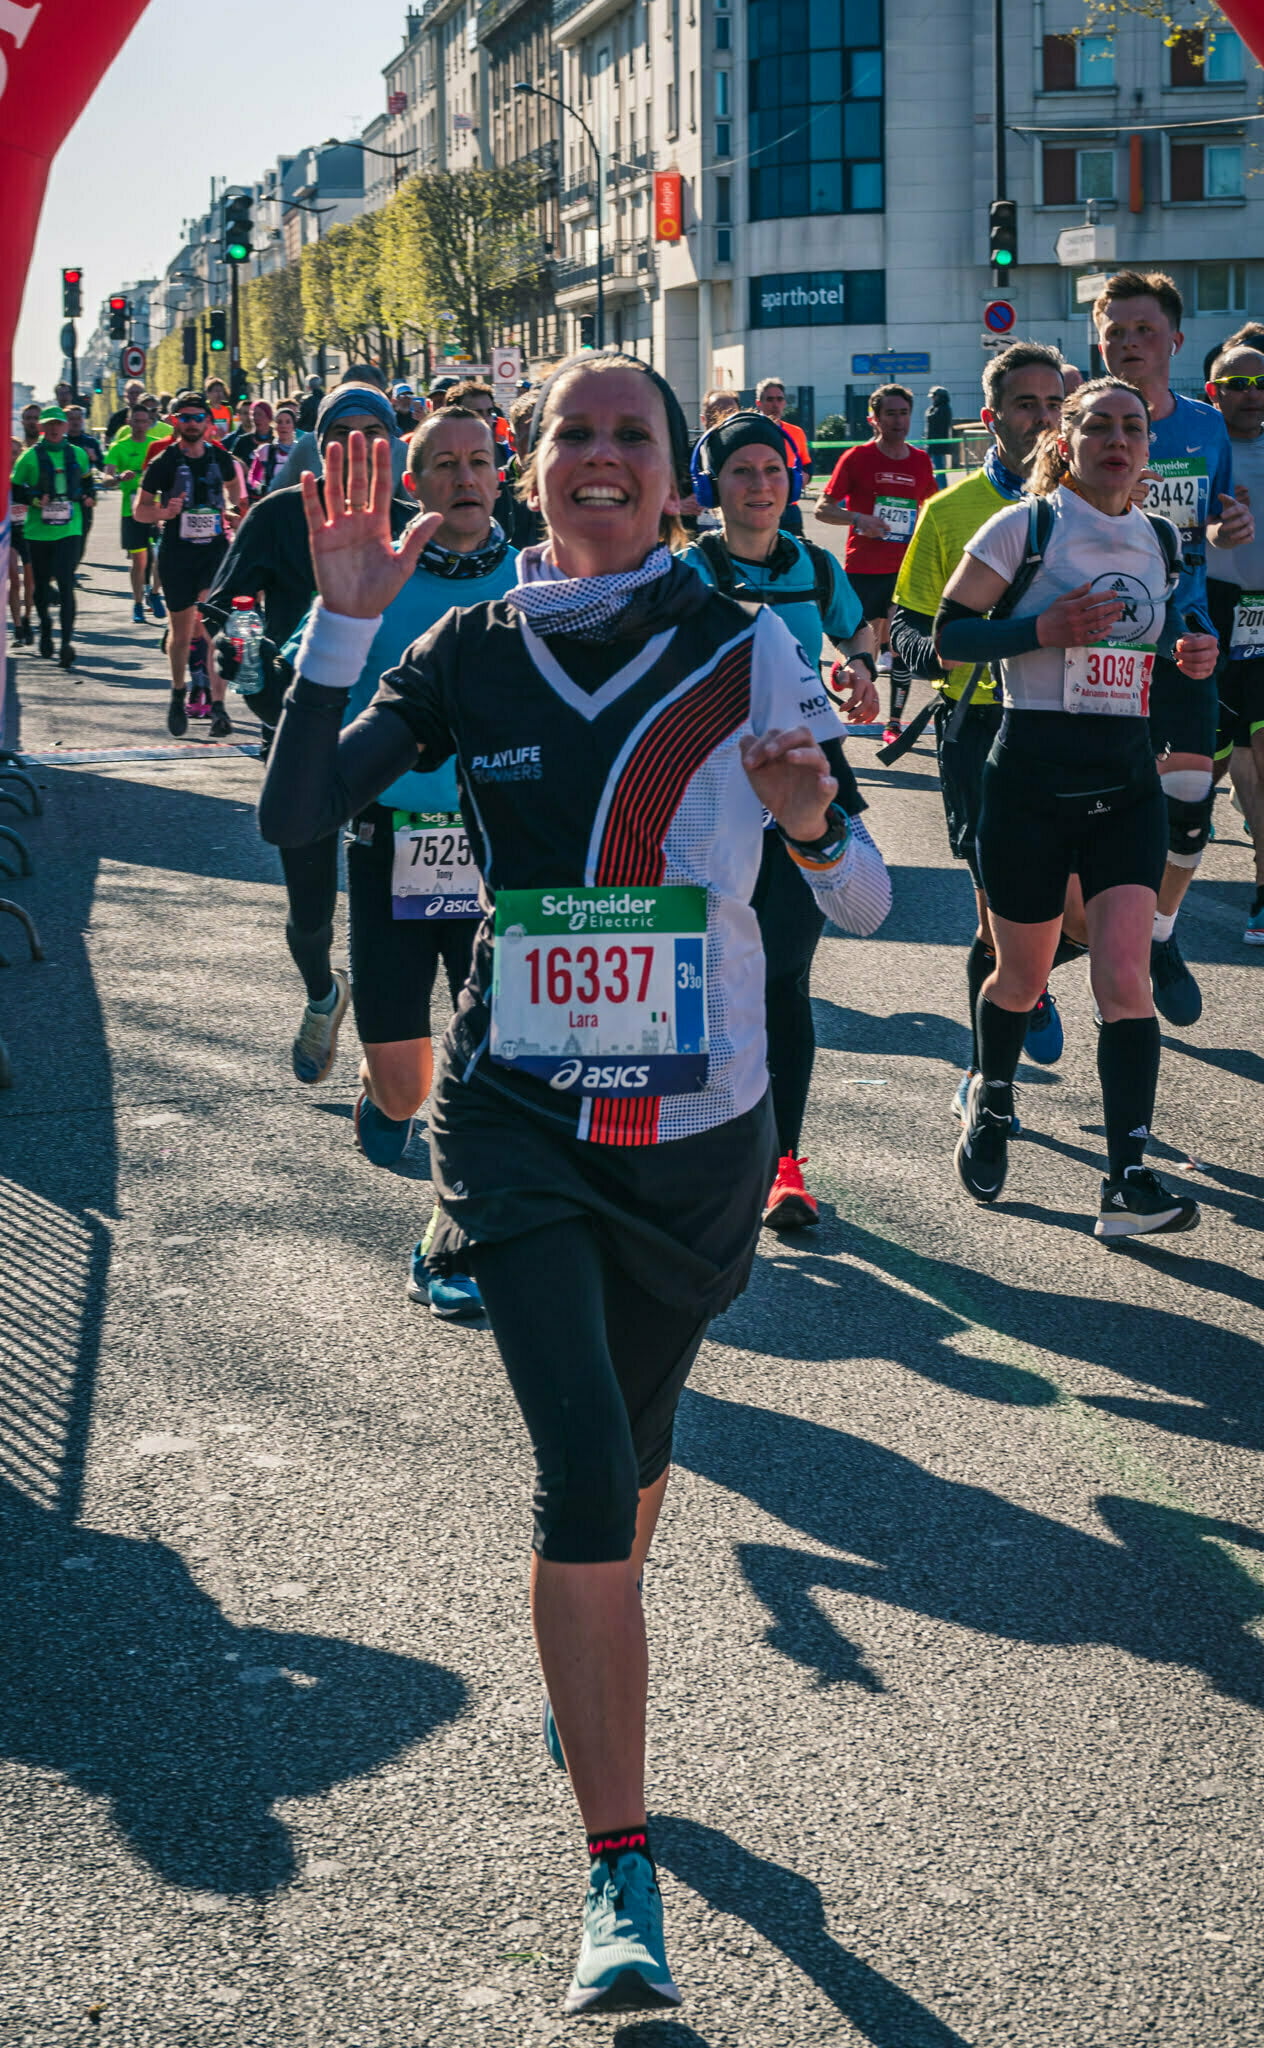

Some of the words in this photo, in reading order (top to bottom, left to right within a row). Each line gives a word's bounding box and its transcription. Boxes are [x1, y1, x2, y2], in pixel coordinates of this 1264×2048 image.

[660, 181, 674, 215] adagio
[761, 284, 844, 312] aparthotel
[1144, 482, 1194, 508] 3442
[1237, 610, 1264, 628] 201
[1087, 654, 1135, 688] 3039
[800, 695, 828, 713] NO
[471, 745, 541, 769] PLAYLIFE
[409, 834, 472, 866] 7525
[541, 894, 656, 916] Schneider
[590, 916, 654, 928] Electric
[525, 945, 655, 1005] 16337
[569, 1011, 599, 1028] Lara
